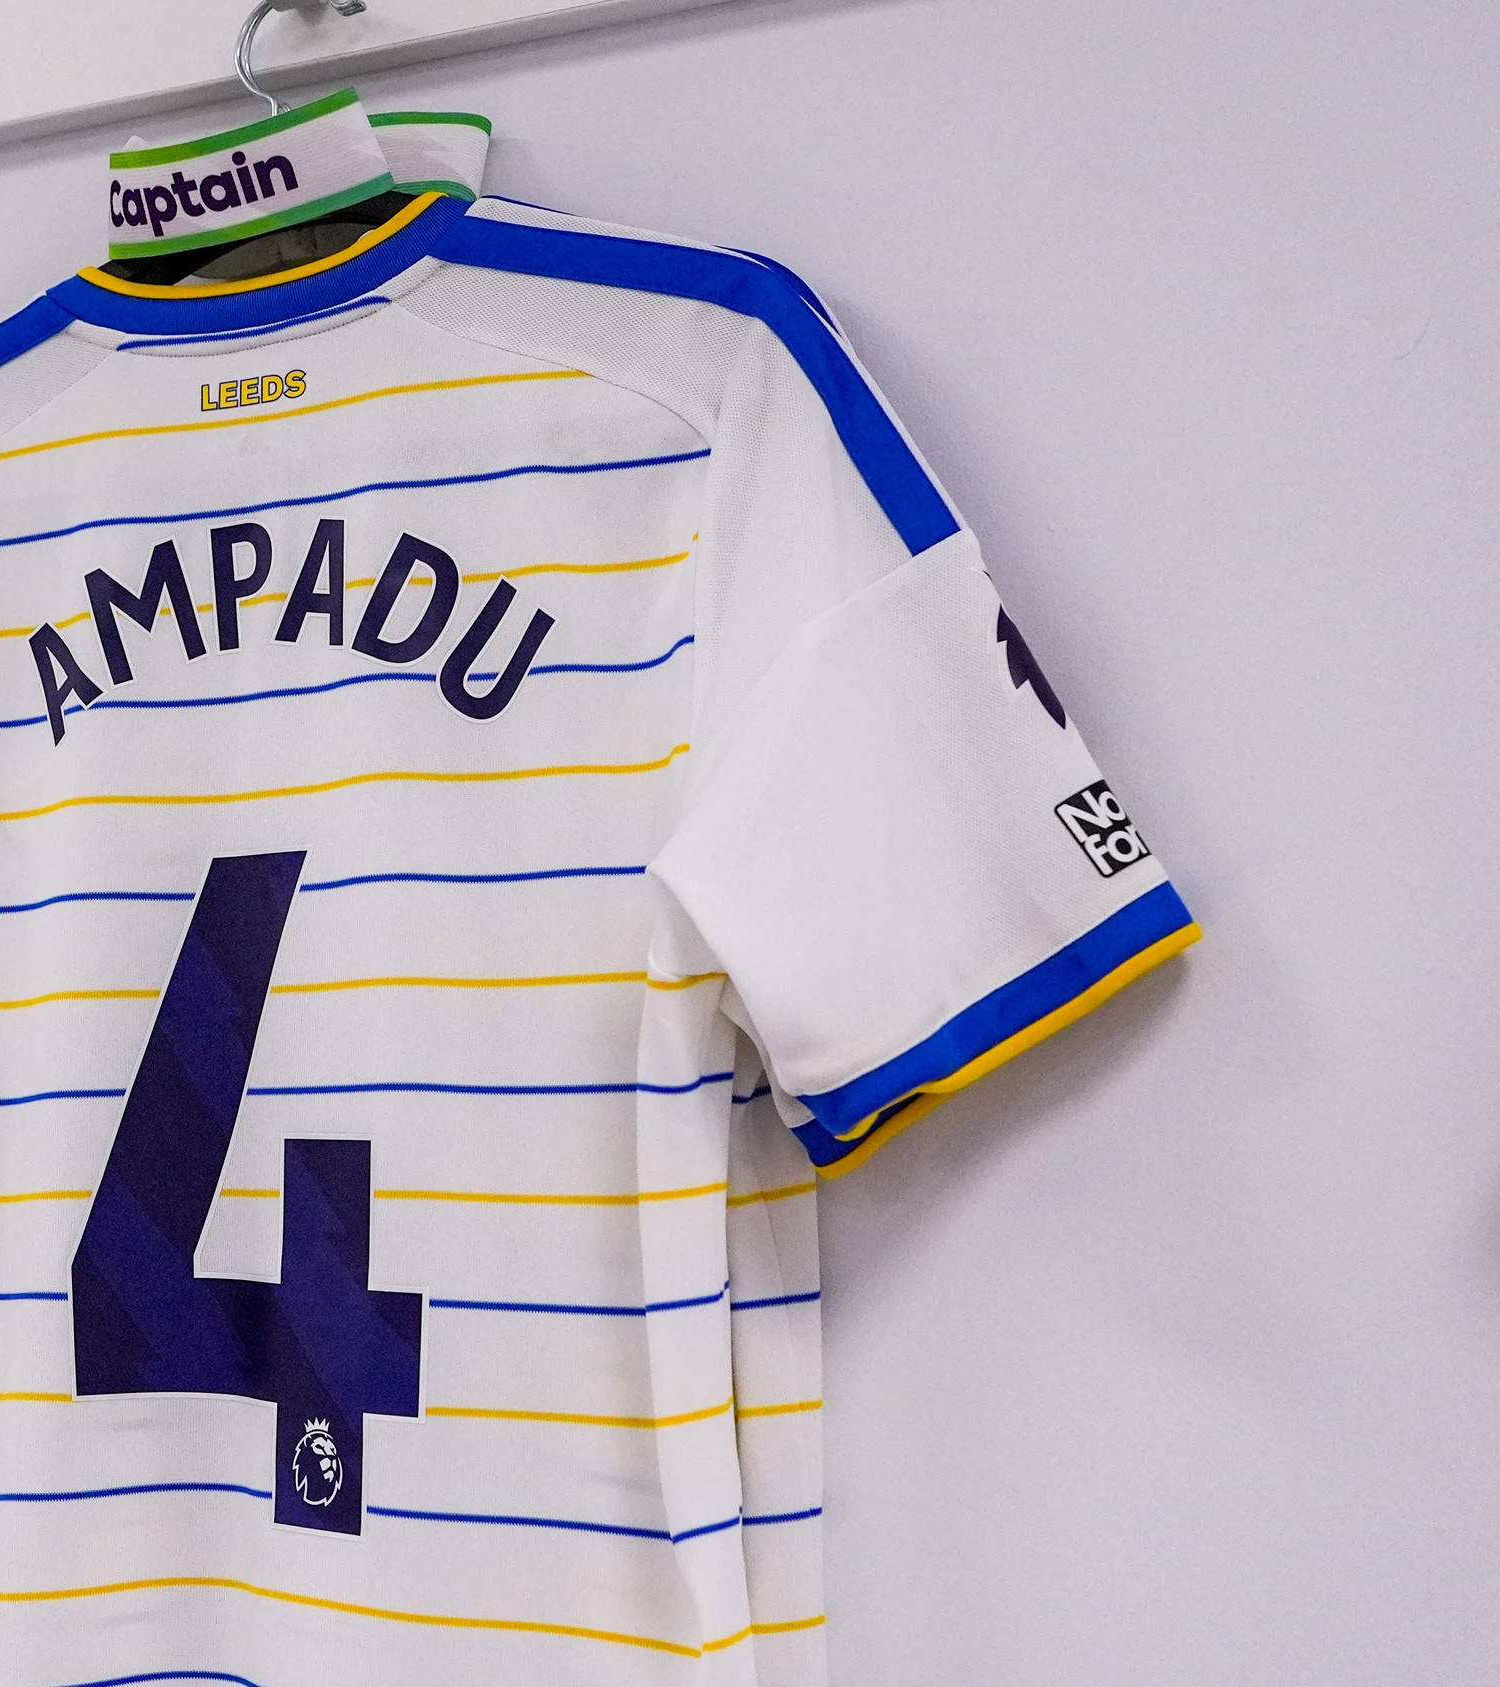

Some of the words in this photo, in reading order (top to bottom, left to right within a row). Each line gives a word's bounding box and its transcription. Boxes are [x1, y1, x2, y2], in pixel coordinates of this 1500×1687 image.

[110, 150, 299, 237] Captain
[201, 369, 307, 411] LEEDS
[28, 518, 556, 747] AMPADU
[1056, 789, 1127, 843] No
[71, 850, 424, 1536] 4
